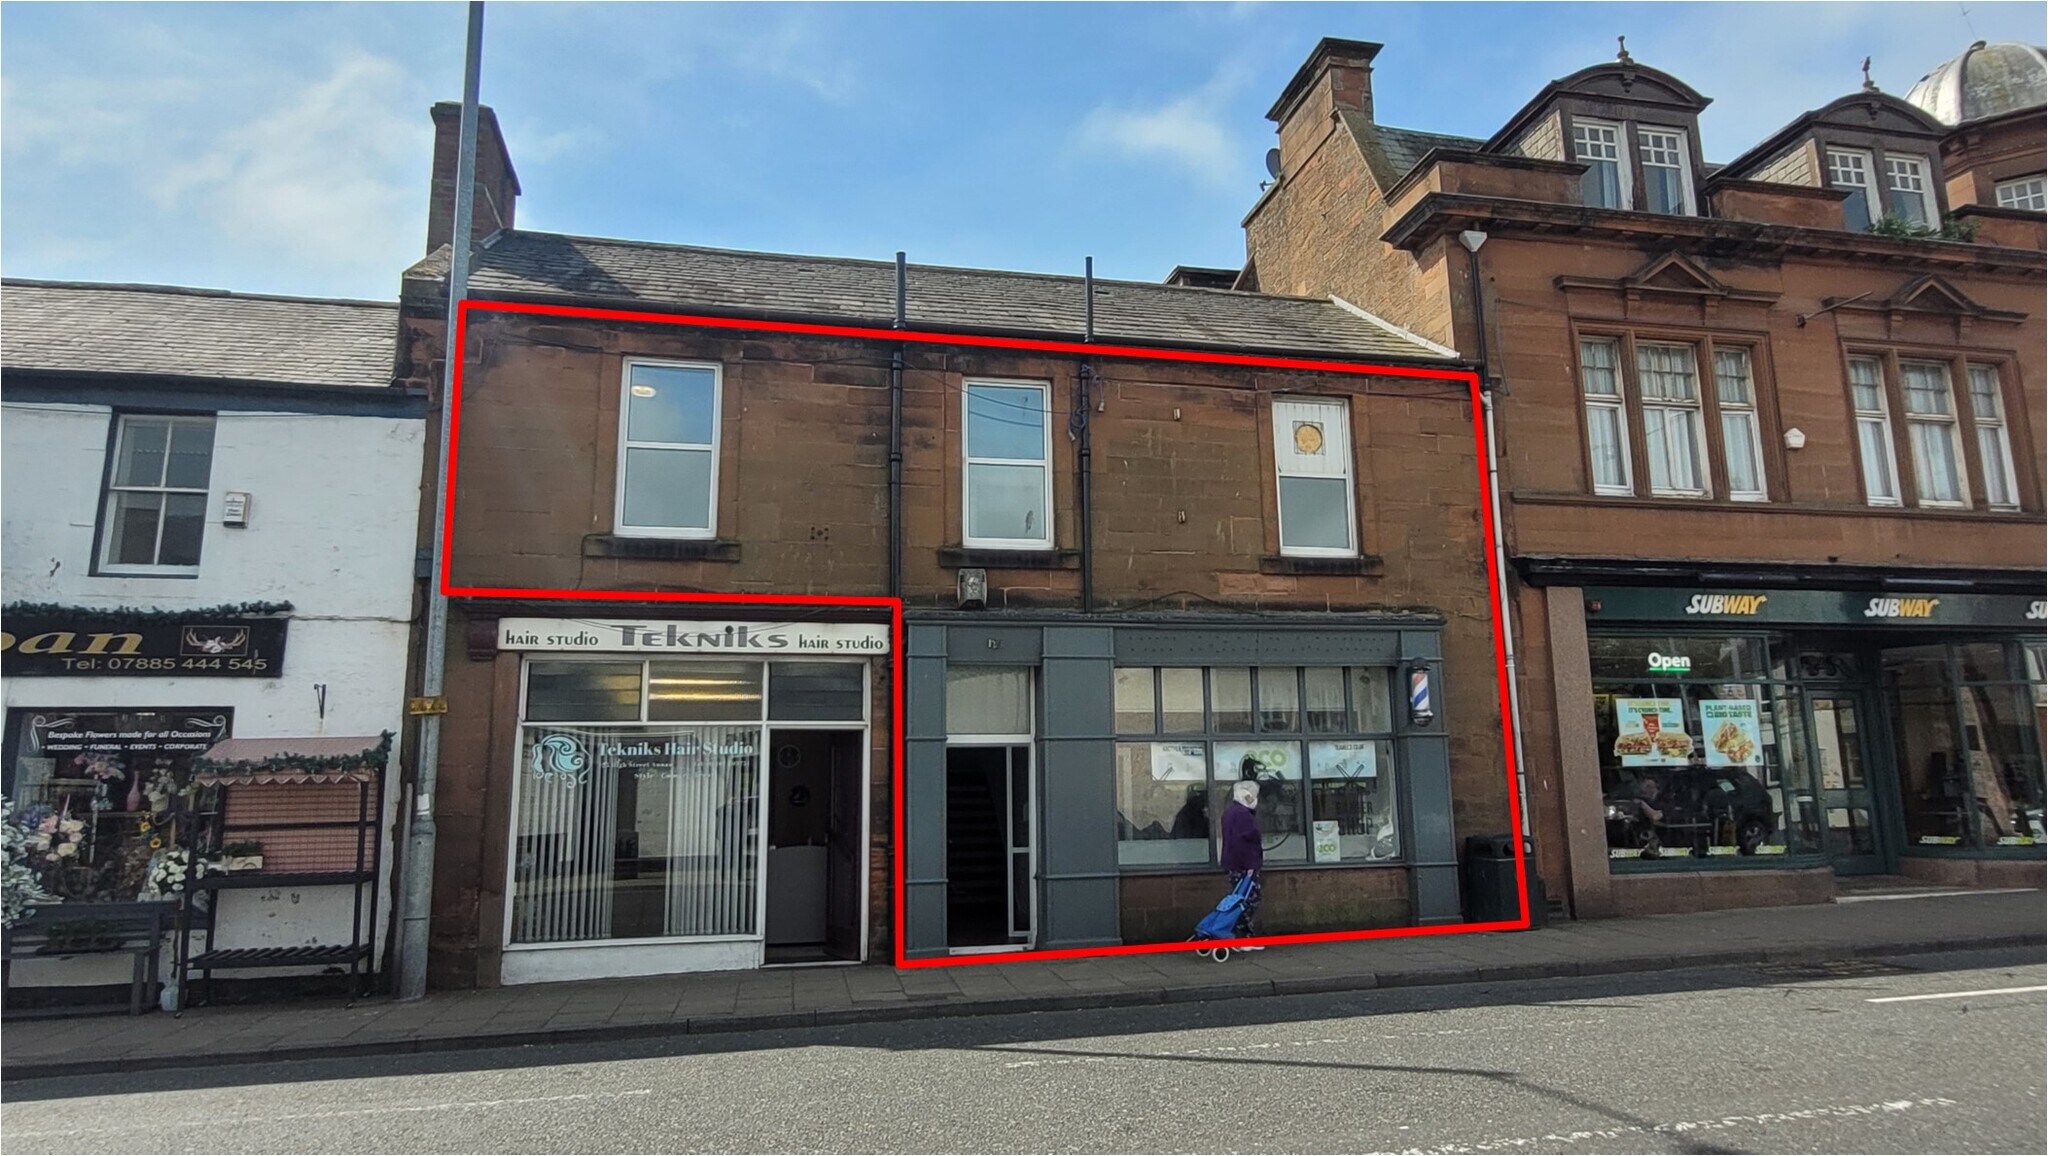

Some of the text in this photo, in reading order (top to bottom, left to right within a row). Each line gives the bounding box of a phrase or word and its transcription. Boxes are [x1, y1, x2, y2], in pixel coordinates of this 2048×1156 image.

[1685, 594, 1767, 615] SUBWAY
[1864, 597, 1940, 617] SUBWAY
[62, 658, 267, 671] Tel: 07885 444 545
[1648, 652, 1691, 668] Open
[48, 731, 83, 739] Bespoke
[85, 731, 117, 739] Flowers
[143, 731, 157, 739] for
[599, 741, 754, 756] Tekniks Hair Studio
